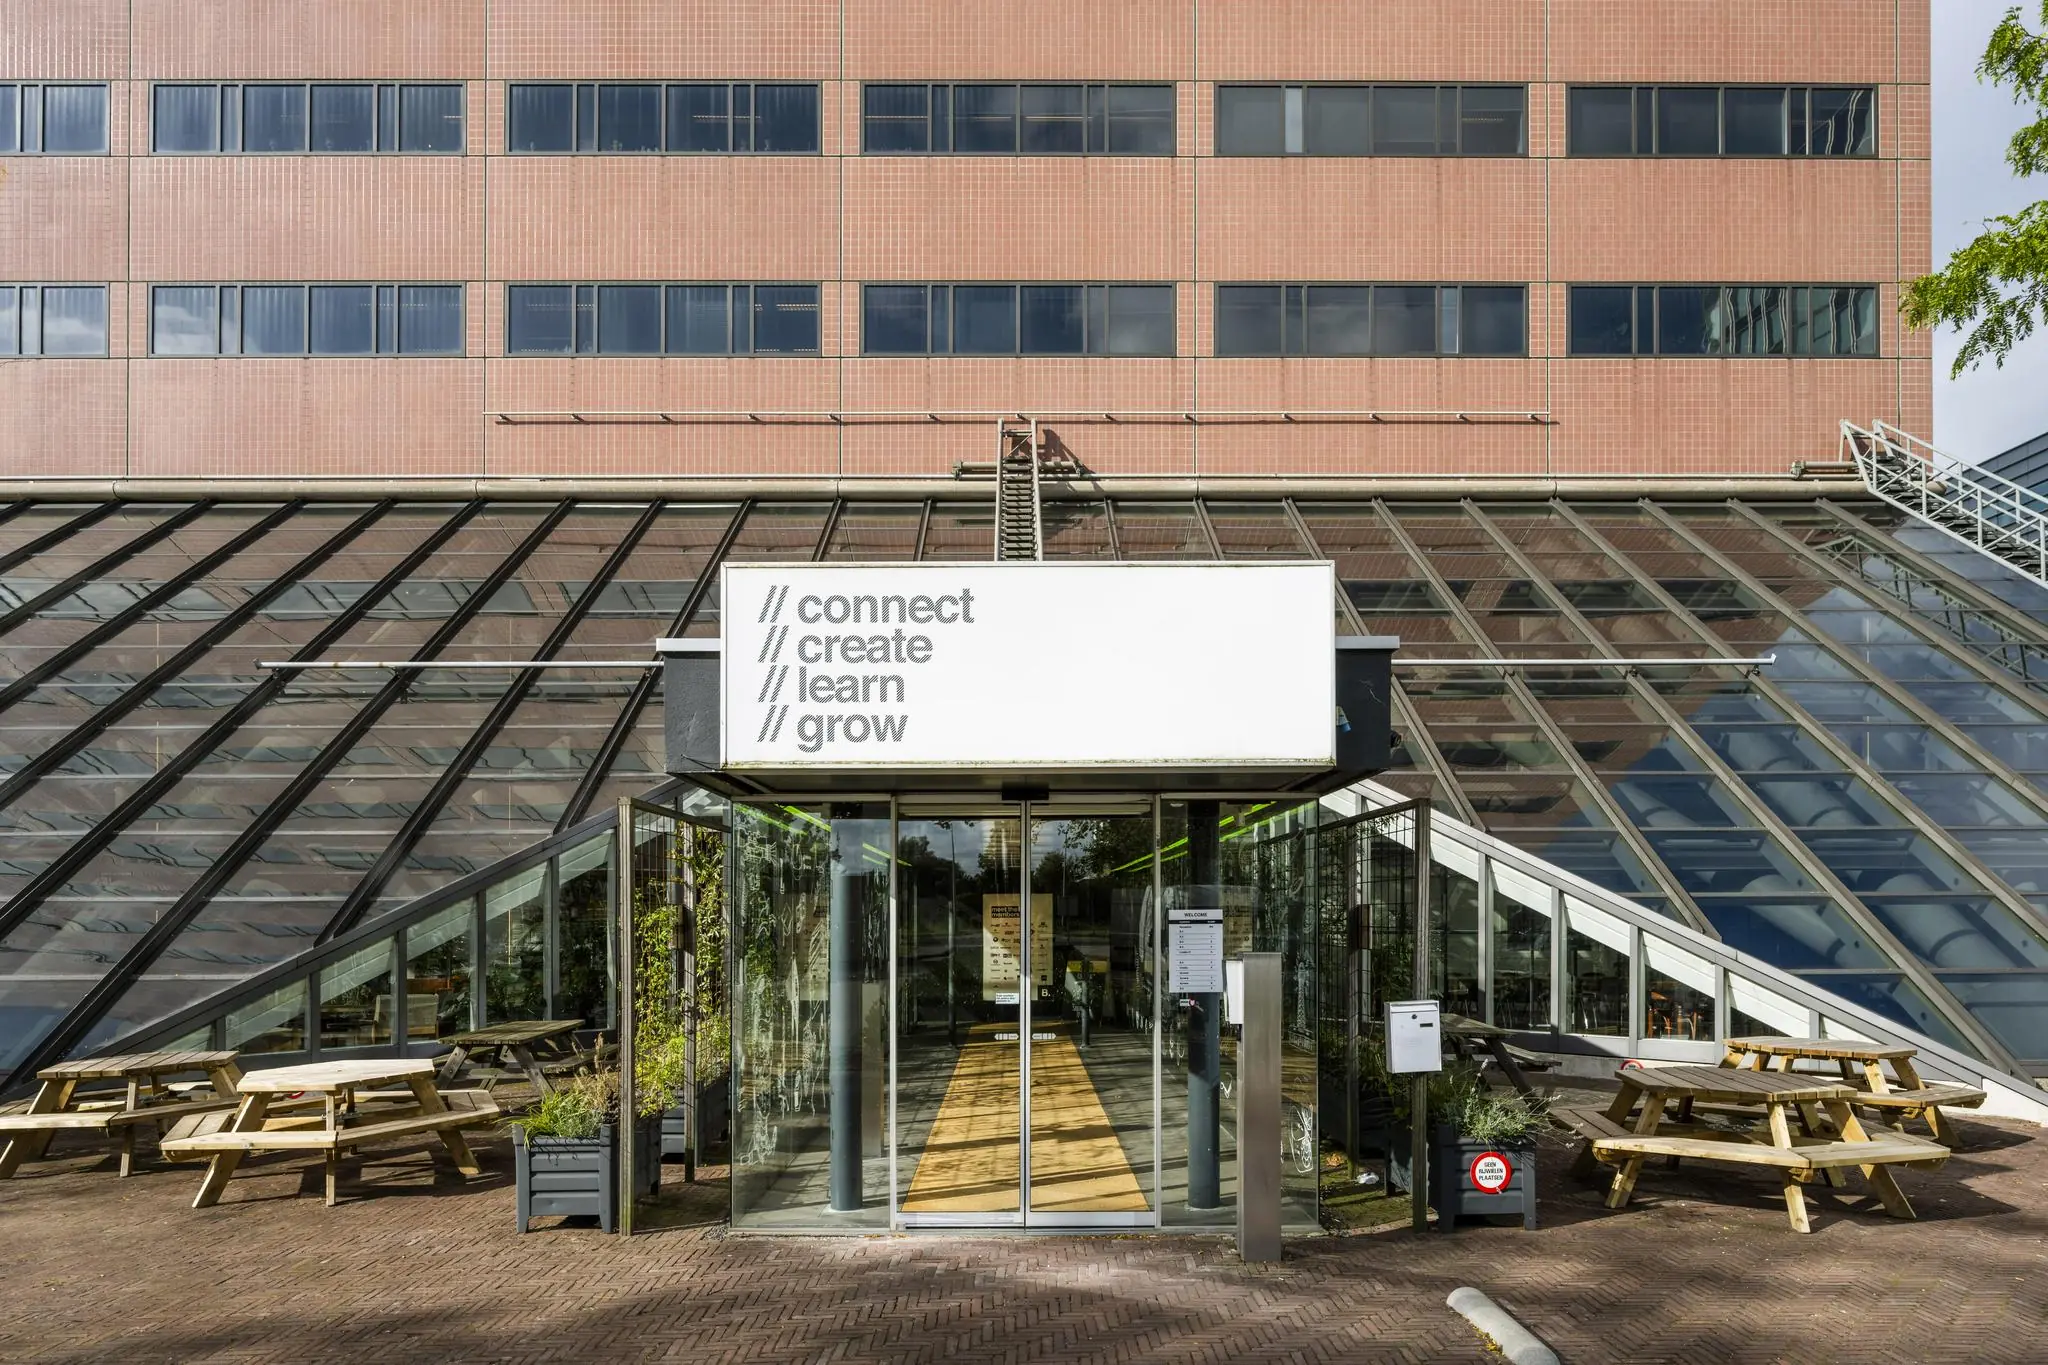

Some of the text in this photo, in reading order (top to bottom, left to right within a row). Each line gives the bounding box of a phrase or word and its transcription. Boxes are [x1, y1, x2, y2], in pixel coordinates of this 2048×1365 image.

[797, 588, 975, 624] connect
[797, 628, 933, 663] create
[798, 666, 905, 703] learn
[797, 714, 908, 752] grow
